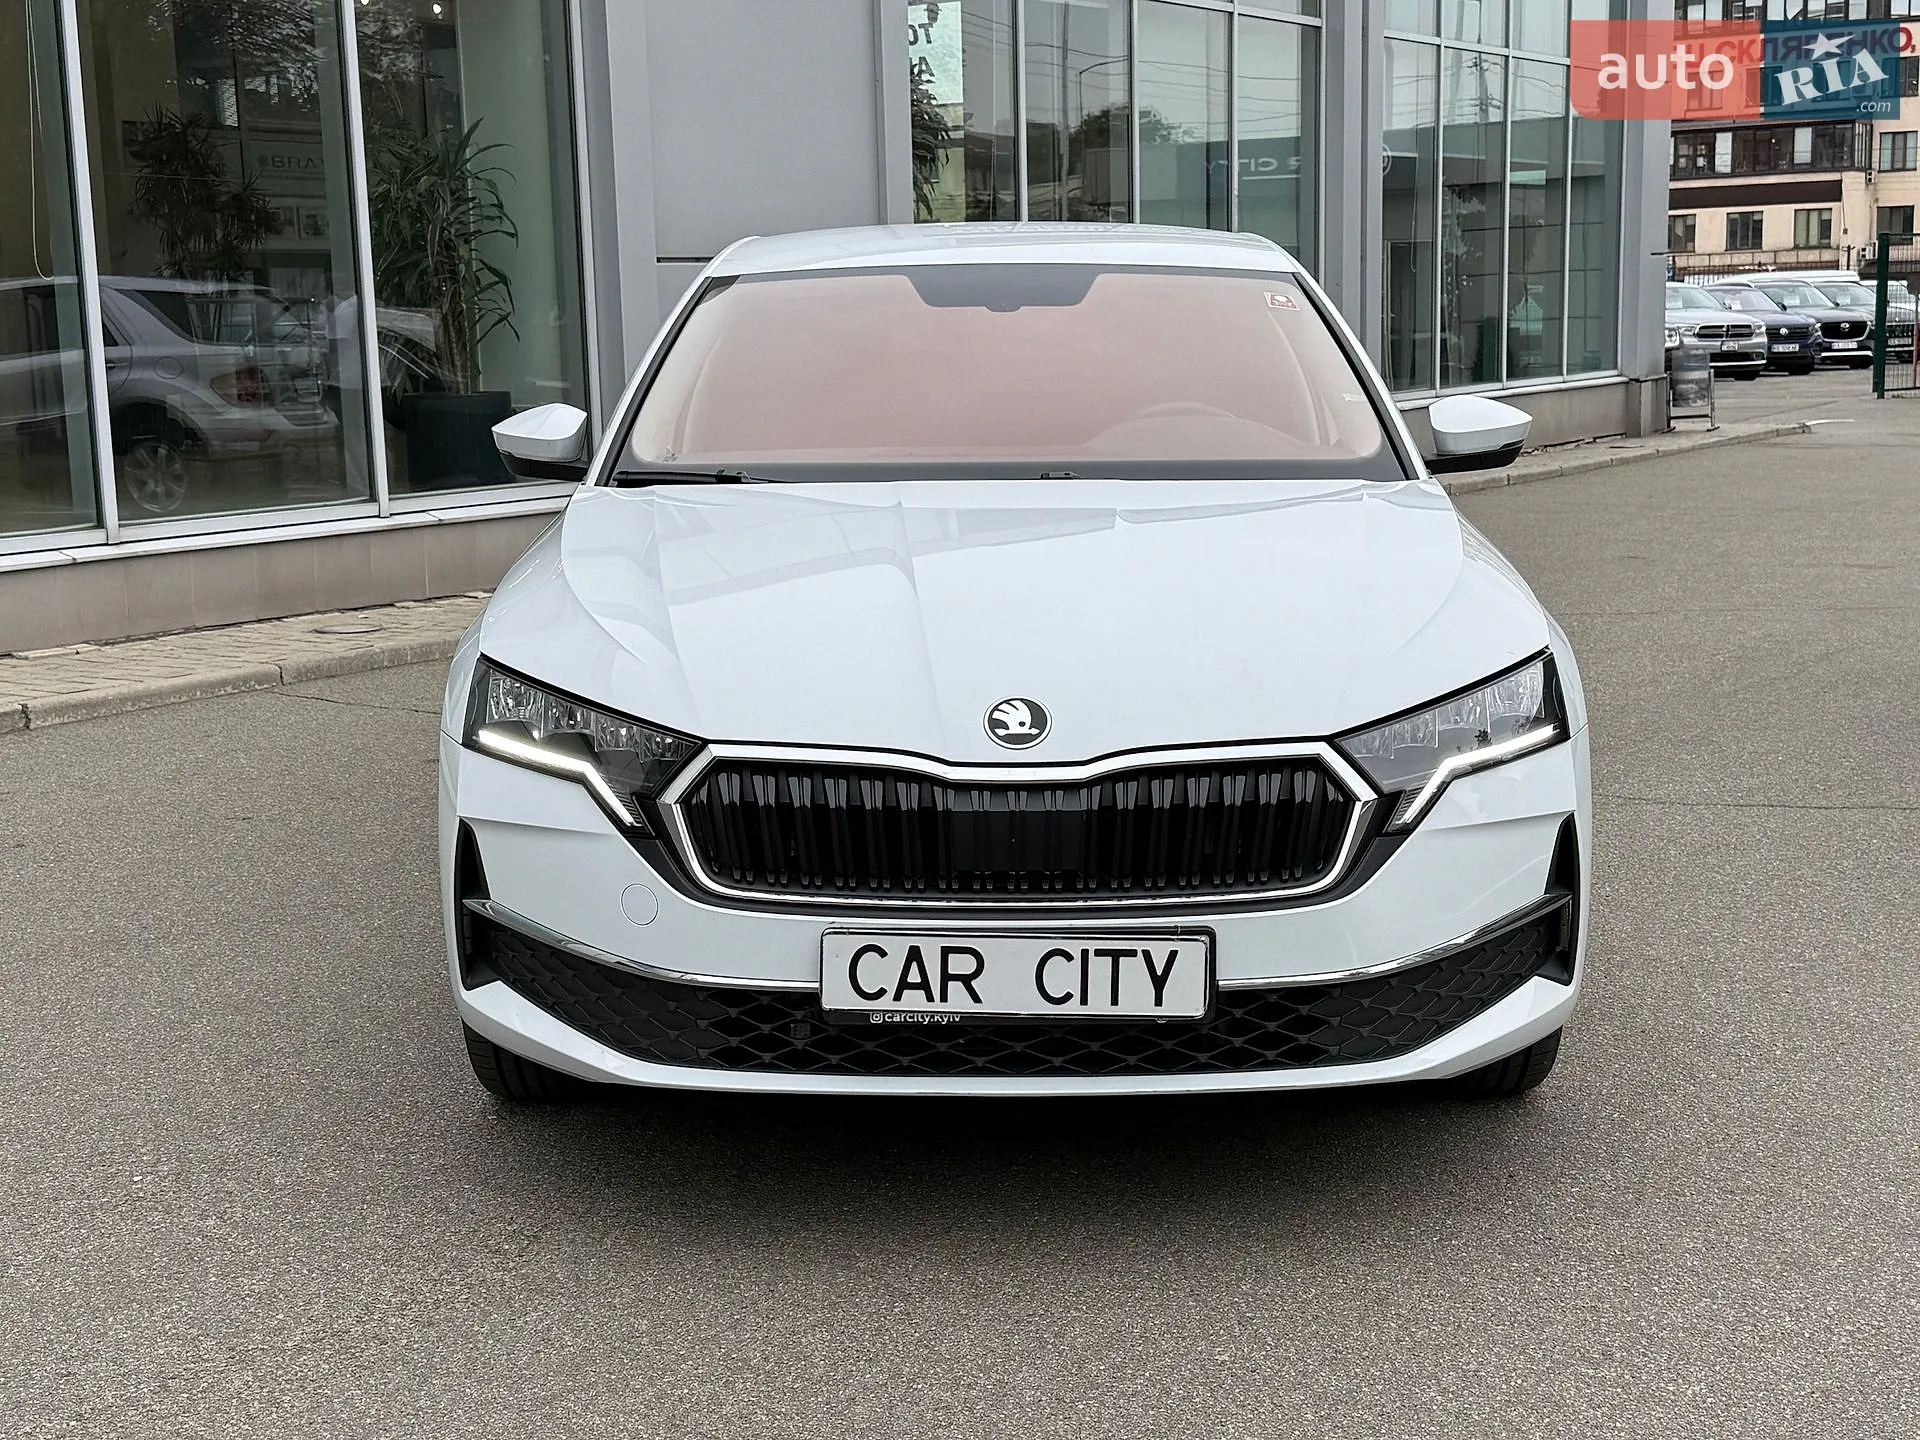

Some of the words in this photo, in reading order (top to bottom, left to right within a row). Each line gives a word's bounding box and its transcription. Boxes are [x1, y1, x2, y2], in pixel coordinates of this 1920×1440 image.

[271, 154, 324, 169] BRA
[847, 943, 985, 1005] CAR
[1034, 947, 1179, 1008] CITY
